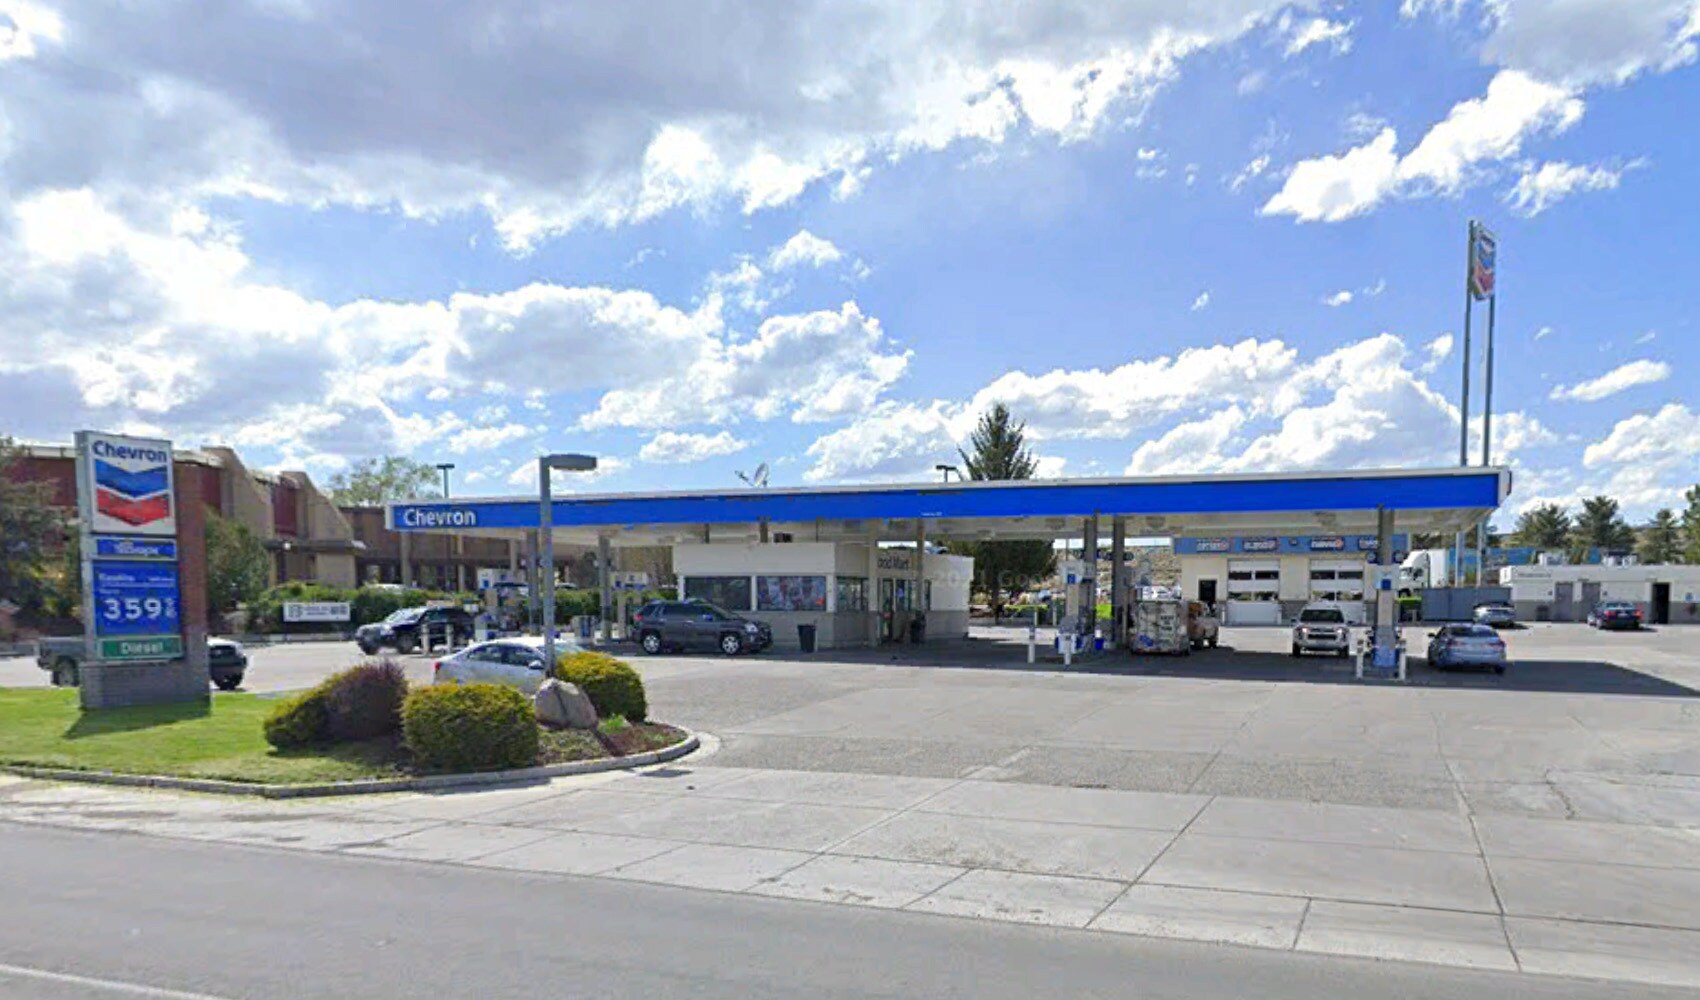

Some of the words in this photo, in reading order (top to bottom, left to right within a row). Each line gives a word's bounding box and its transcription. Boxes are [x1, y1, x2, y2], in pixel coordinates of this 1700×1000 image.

[93, 440, 167, 463] Chevron
[403, 508, 477, 526] Chevron
[103, 598, 162, 620] 359
[121, 642, 163, 656] Diesel
